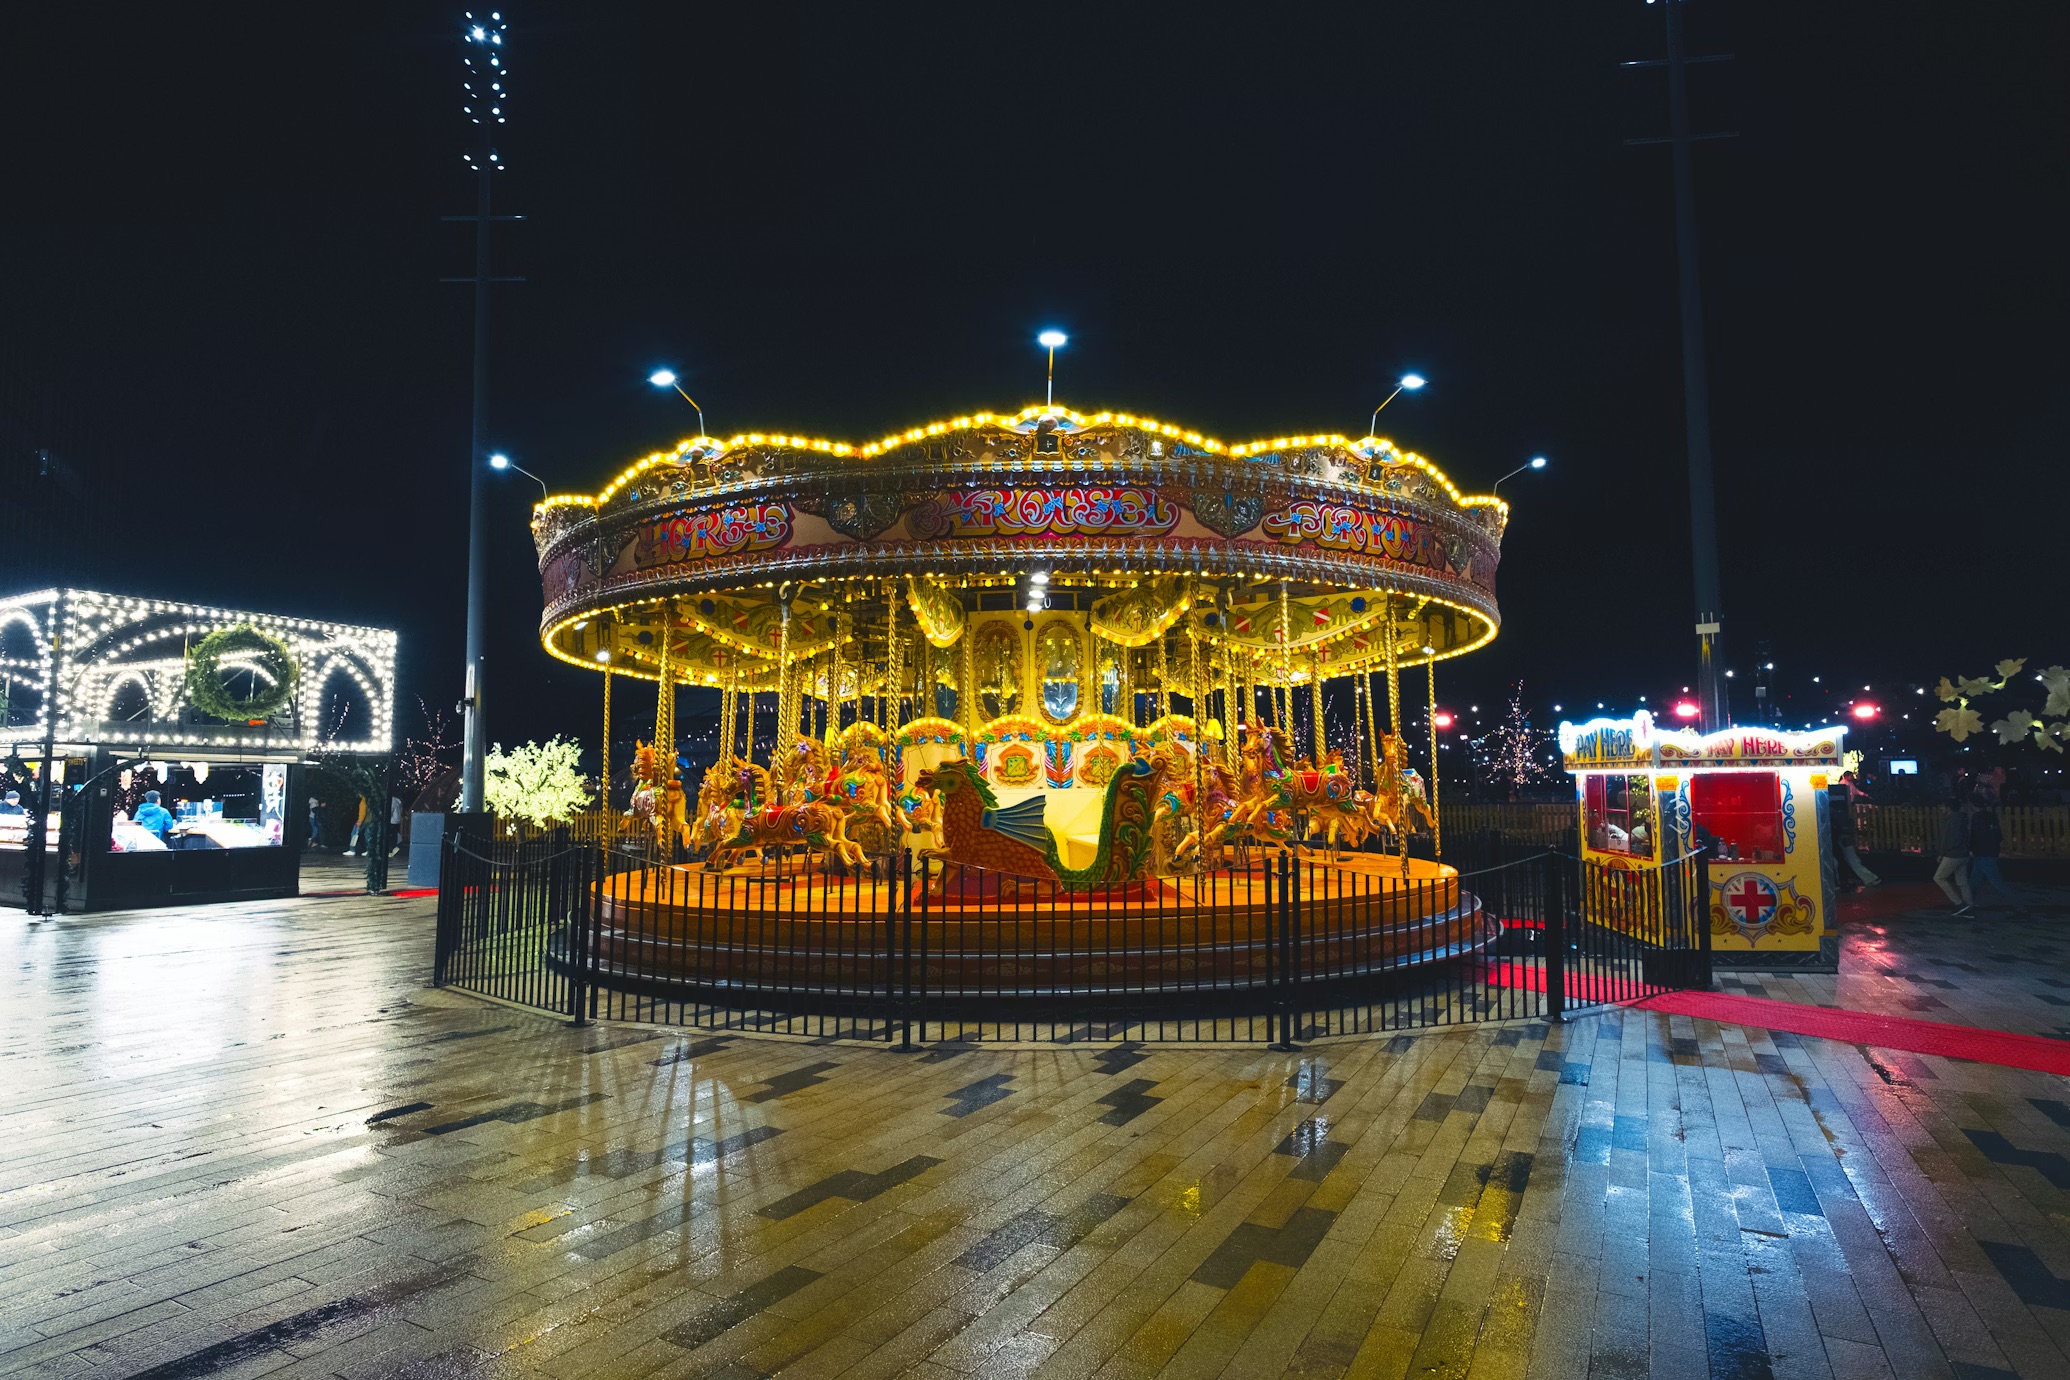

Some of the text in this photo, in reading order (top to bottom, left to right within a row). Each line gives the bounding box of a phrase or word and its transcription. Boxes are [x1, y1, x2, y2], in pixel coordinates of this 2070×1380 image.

[636, 502, 789, 565] HORSE
[906, 488, 1180, 537] CAROUSEL
[1264, 501, 1366, 549] FOR
[1576, 727, 1635, 760] PAY HERE
[1706, 736, 1788, 758] PAY HERE
